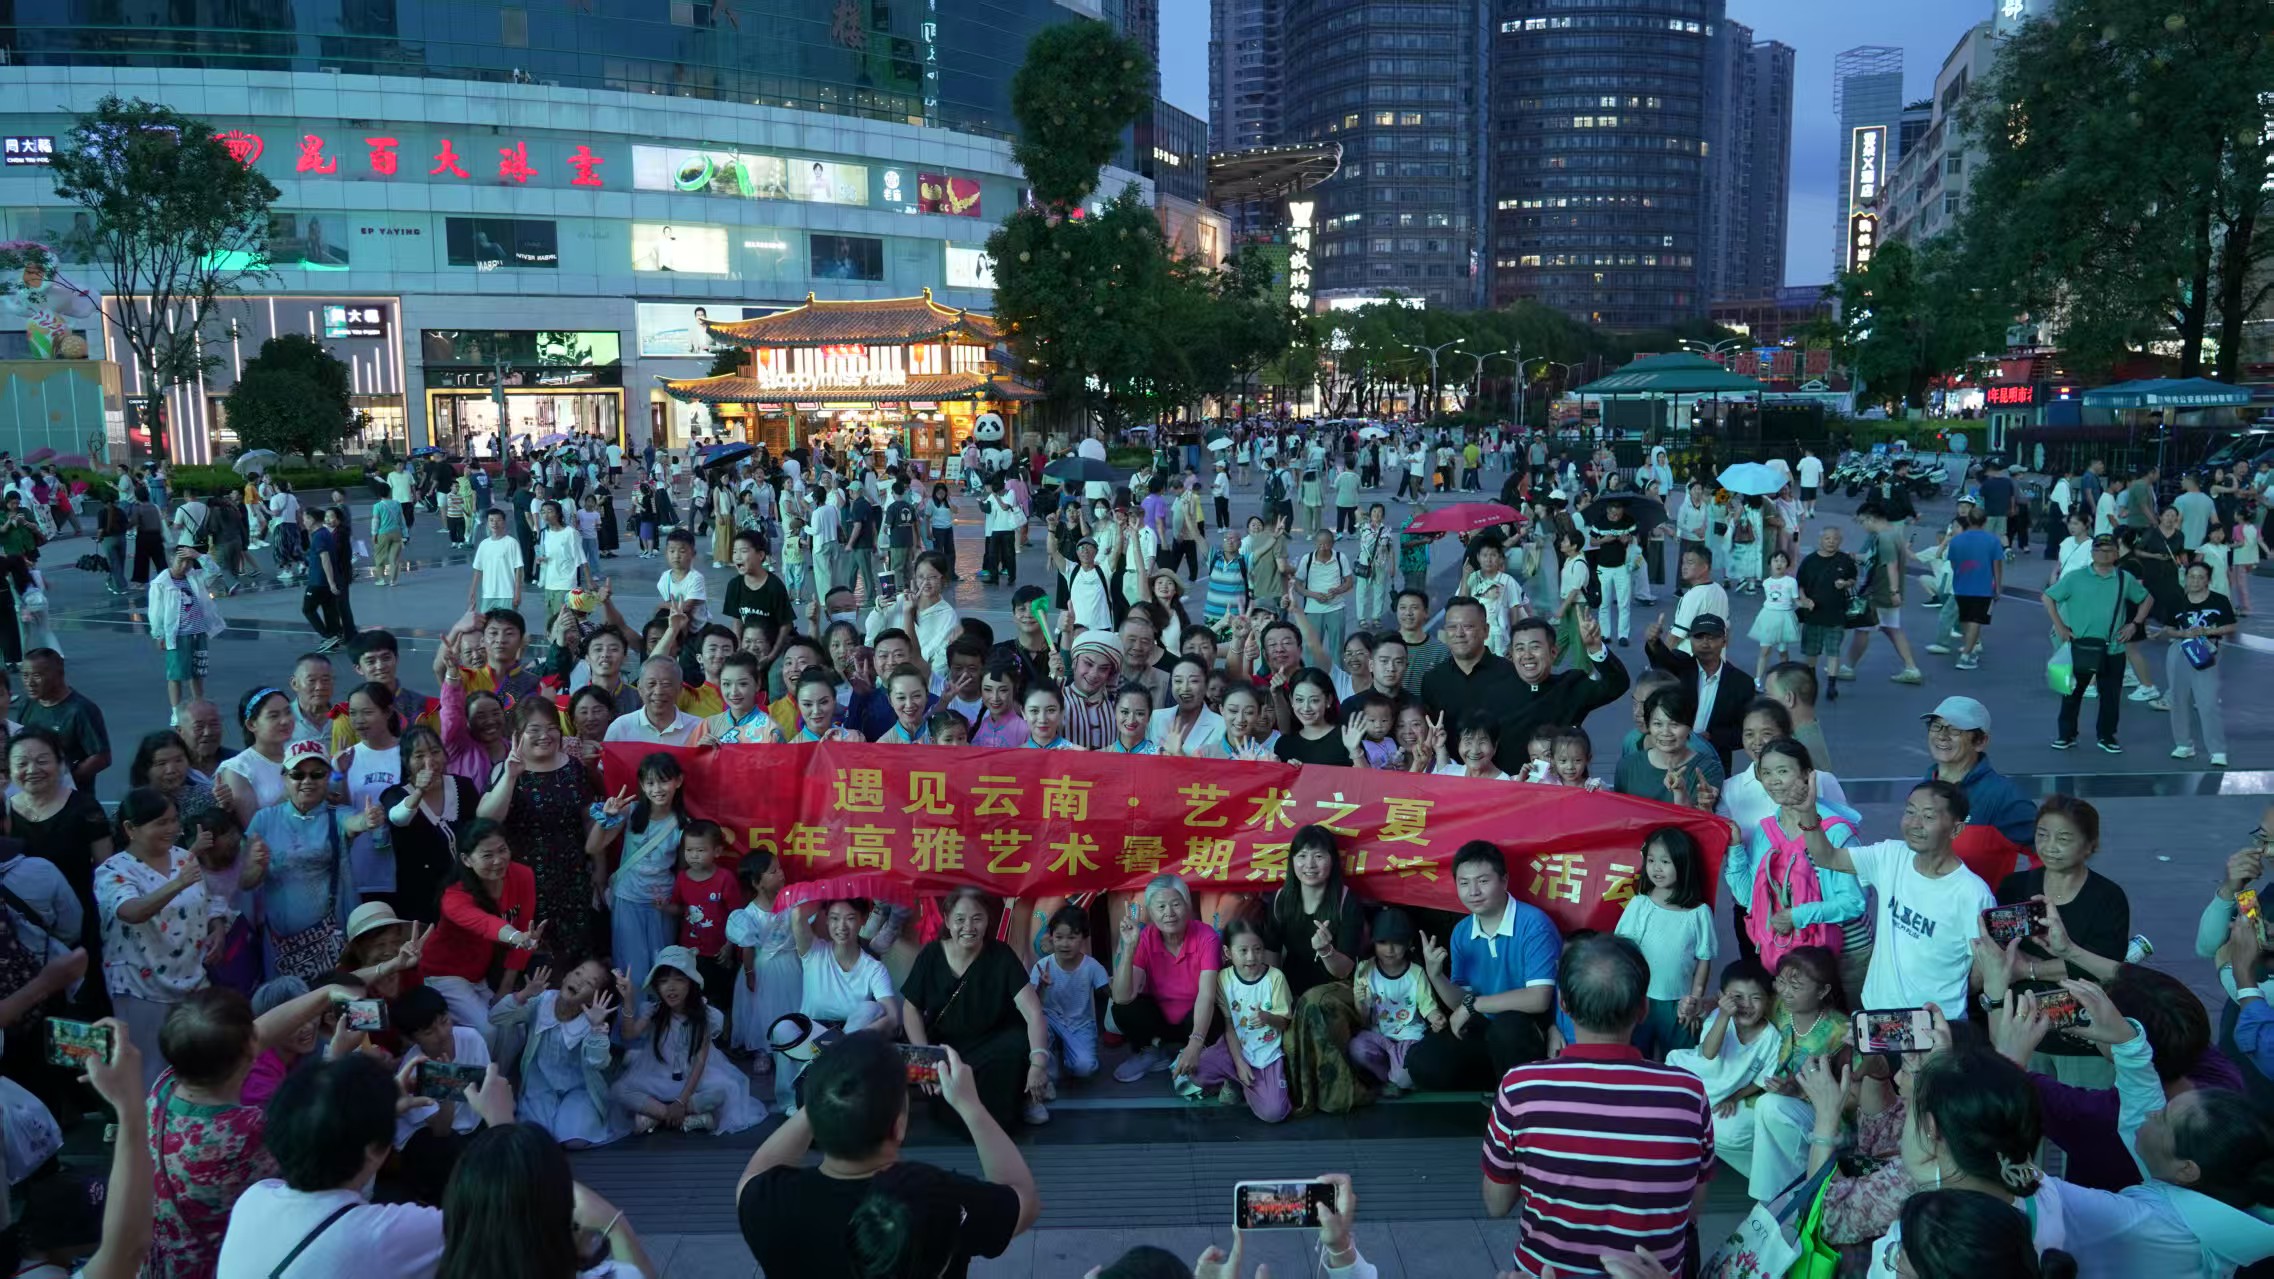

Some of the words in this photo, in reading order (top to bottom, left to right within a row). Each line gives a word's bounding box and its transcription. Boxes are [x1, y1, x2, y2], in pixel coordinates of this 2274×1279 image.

[296, 134, 605, 187] 昆百大珠宝
[379, 228, 420, 236] YAYING
[363, 771, 395, 786] NIKE
[833, 767, 1434, 847] 遇见云南·艺术之夏
